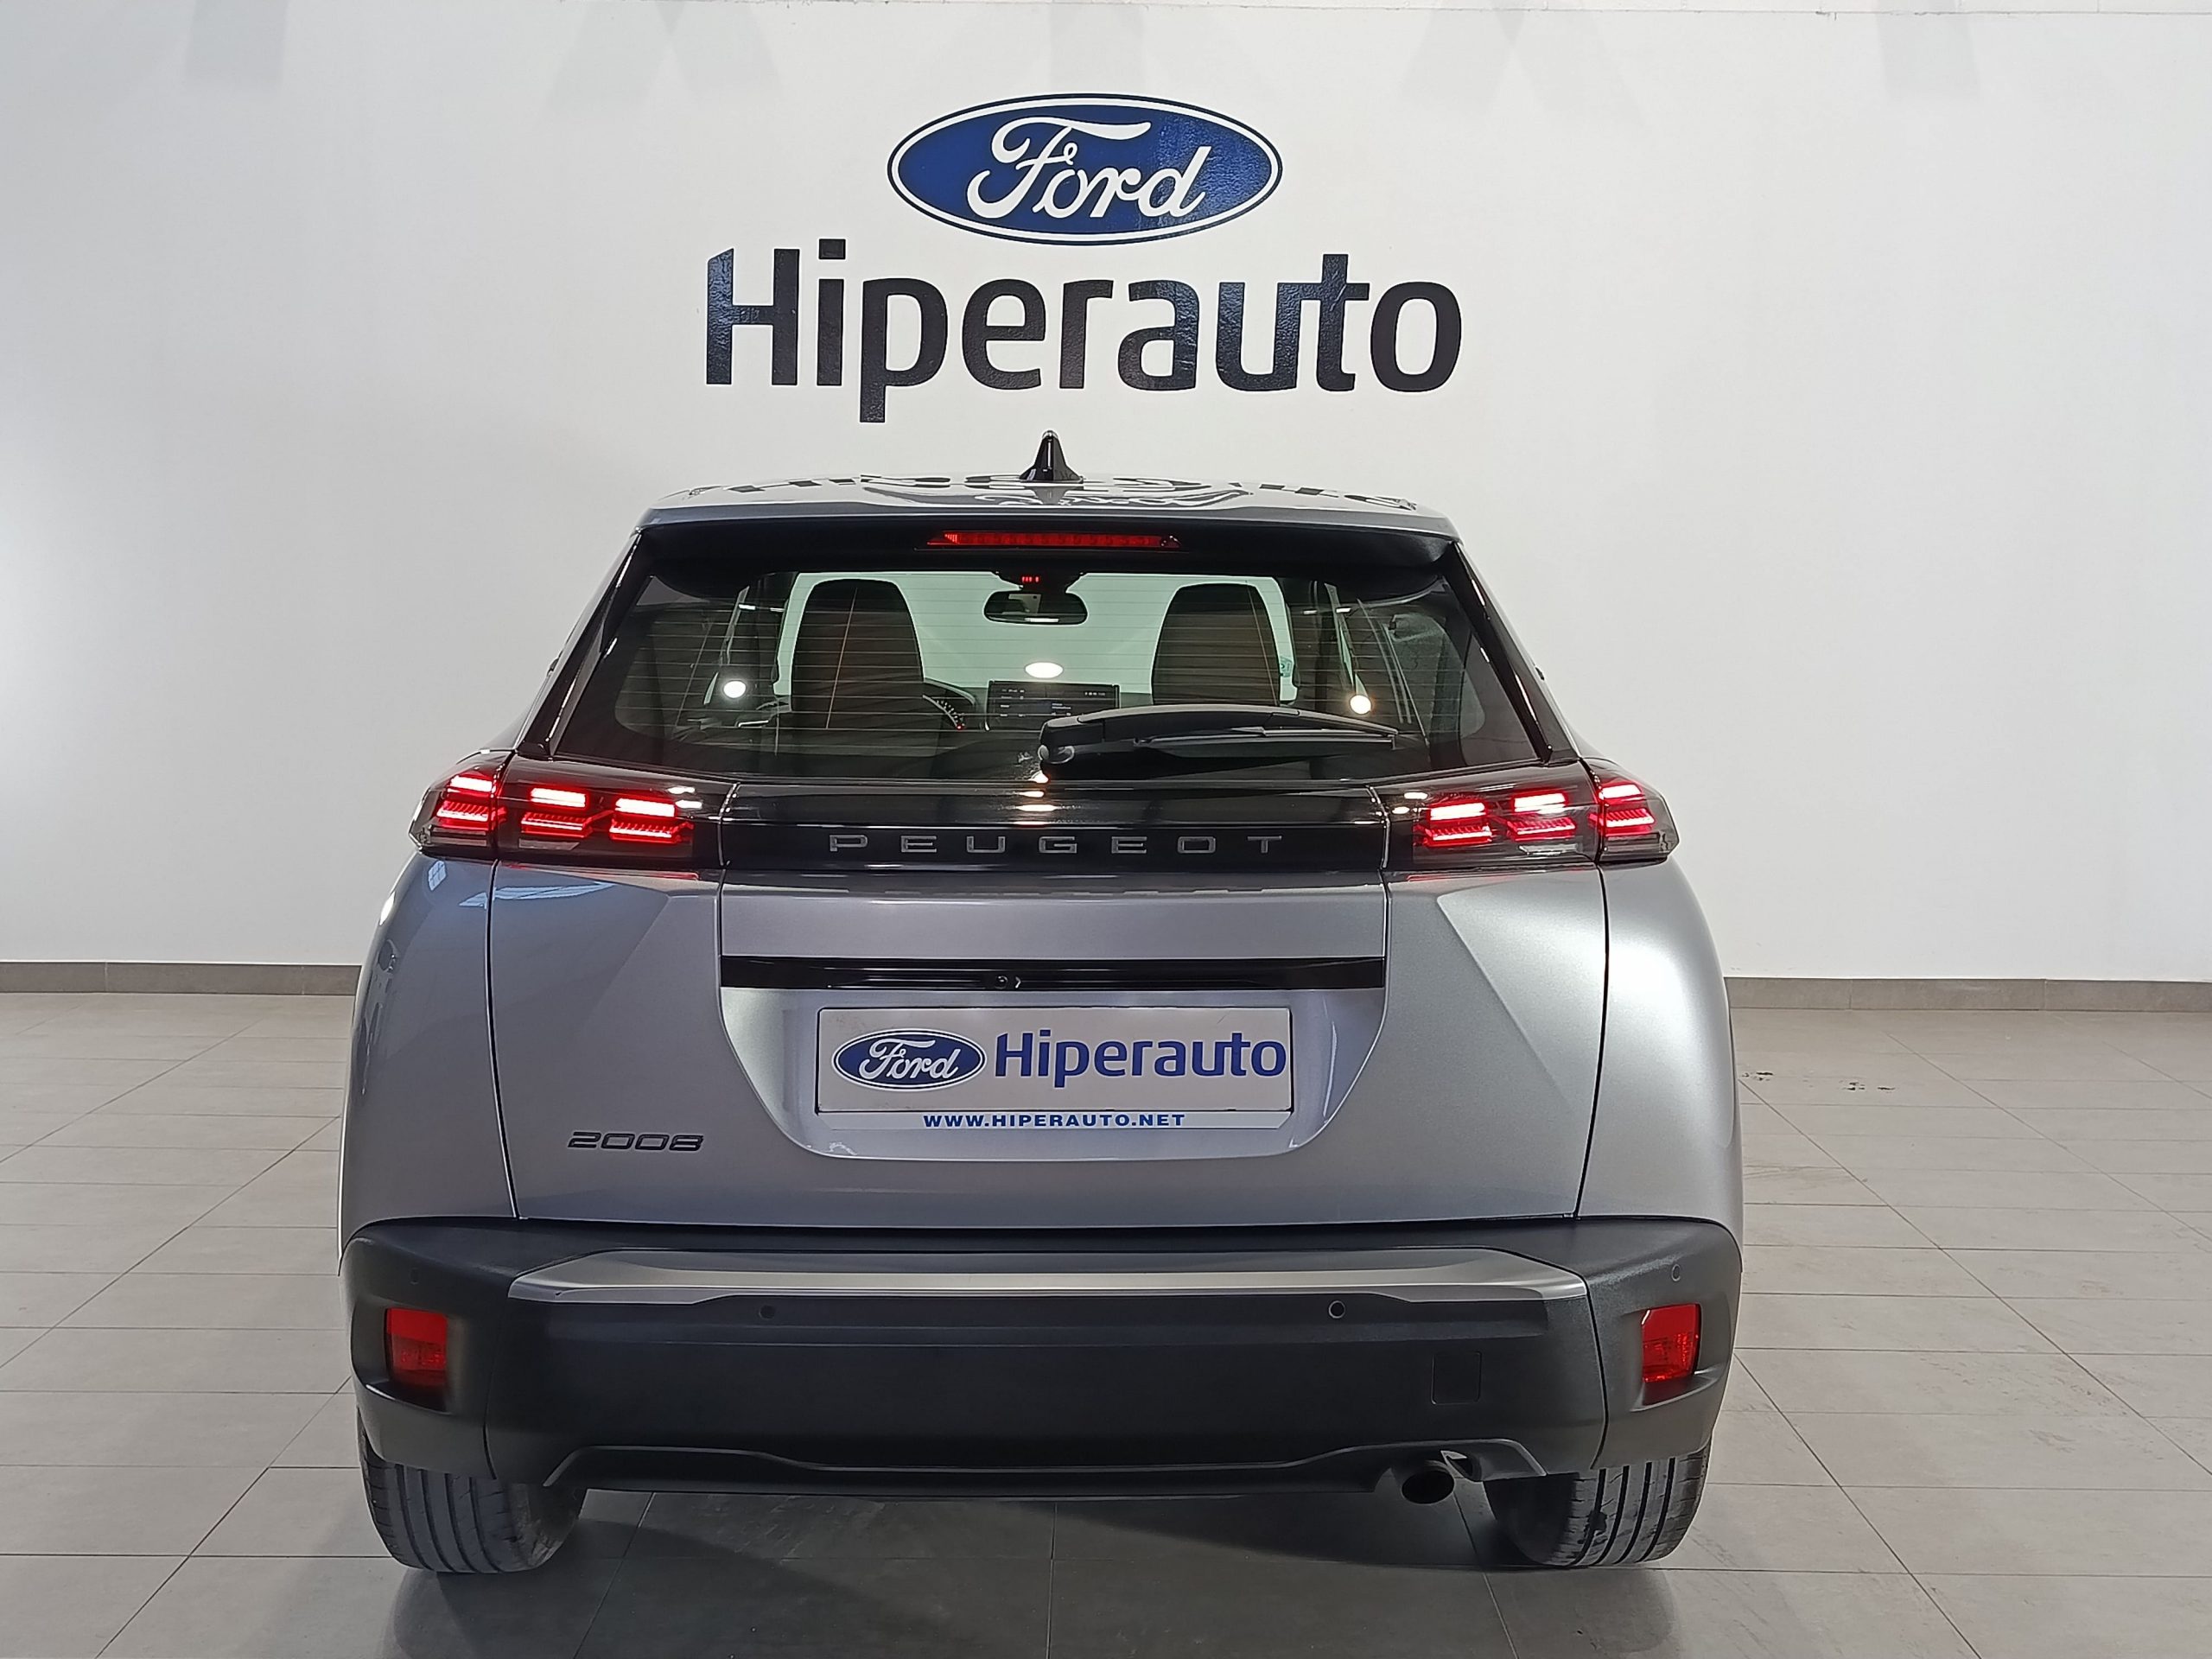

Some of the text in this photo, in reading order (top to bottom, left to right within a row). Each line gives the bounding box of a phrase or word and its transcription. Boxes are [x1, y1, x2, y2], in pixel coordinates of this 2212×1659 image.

[966, 117, 1212, 219] Ford
[706, 238, 1462, 423] Hiperauto
[829, 834, 1282, 854] PEUGEOT
[858, 1038, 961, 1080] Ford
[995, 1029, 1287, 1088] Hiperauto
[567, 1131, 704, 1152] 2008
[923, 1114, 1185, 1128] WWW.HIPERAUTO.NET
